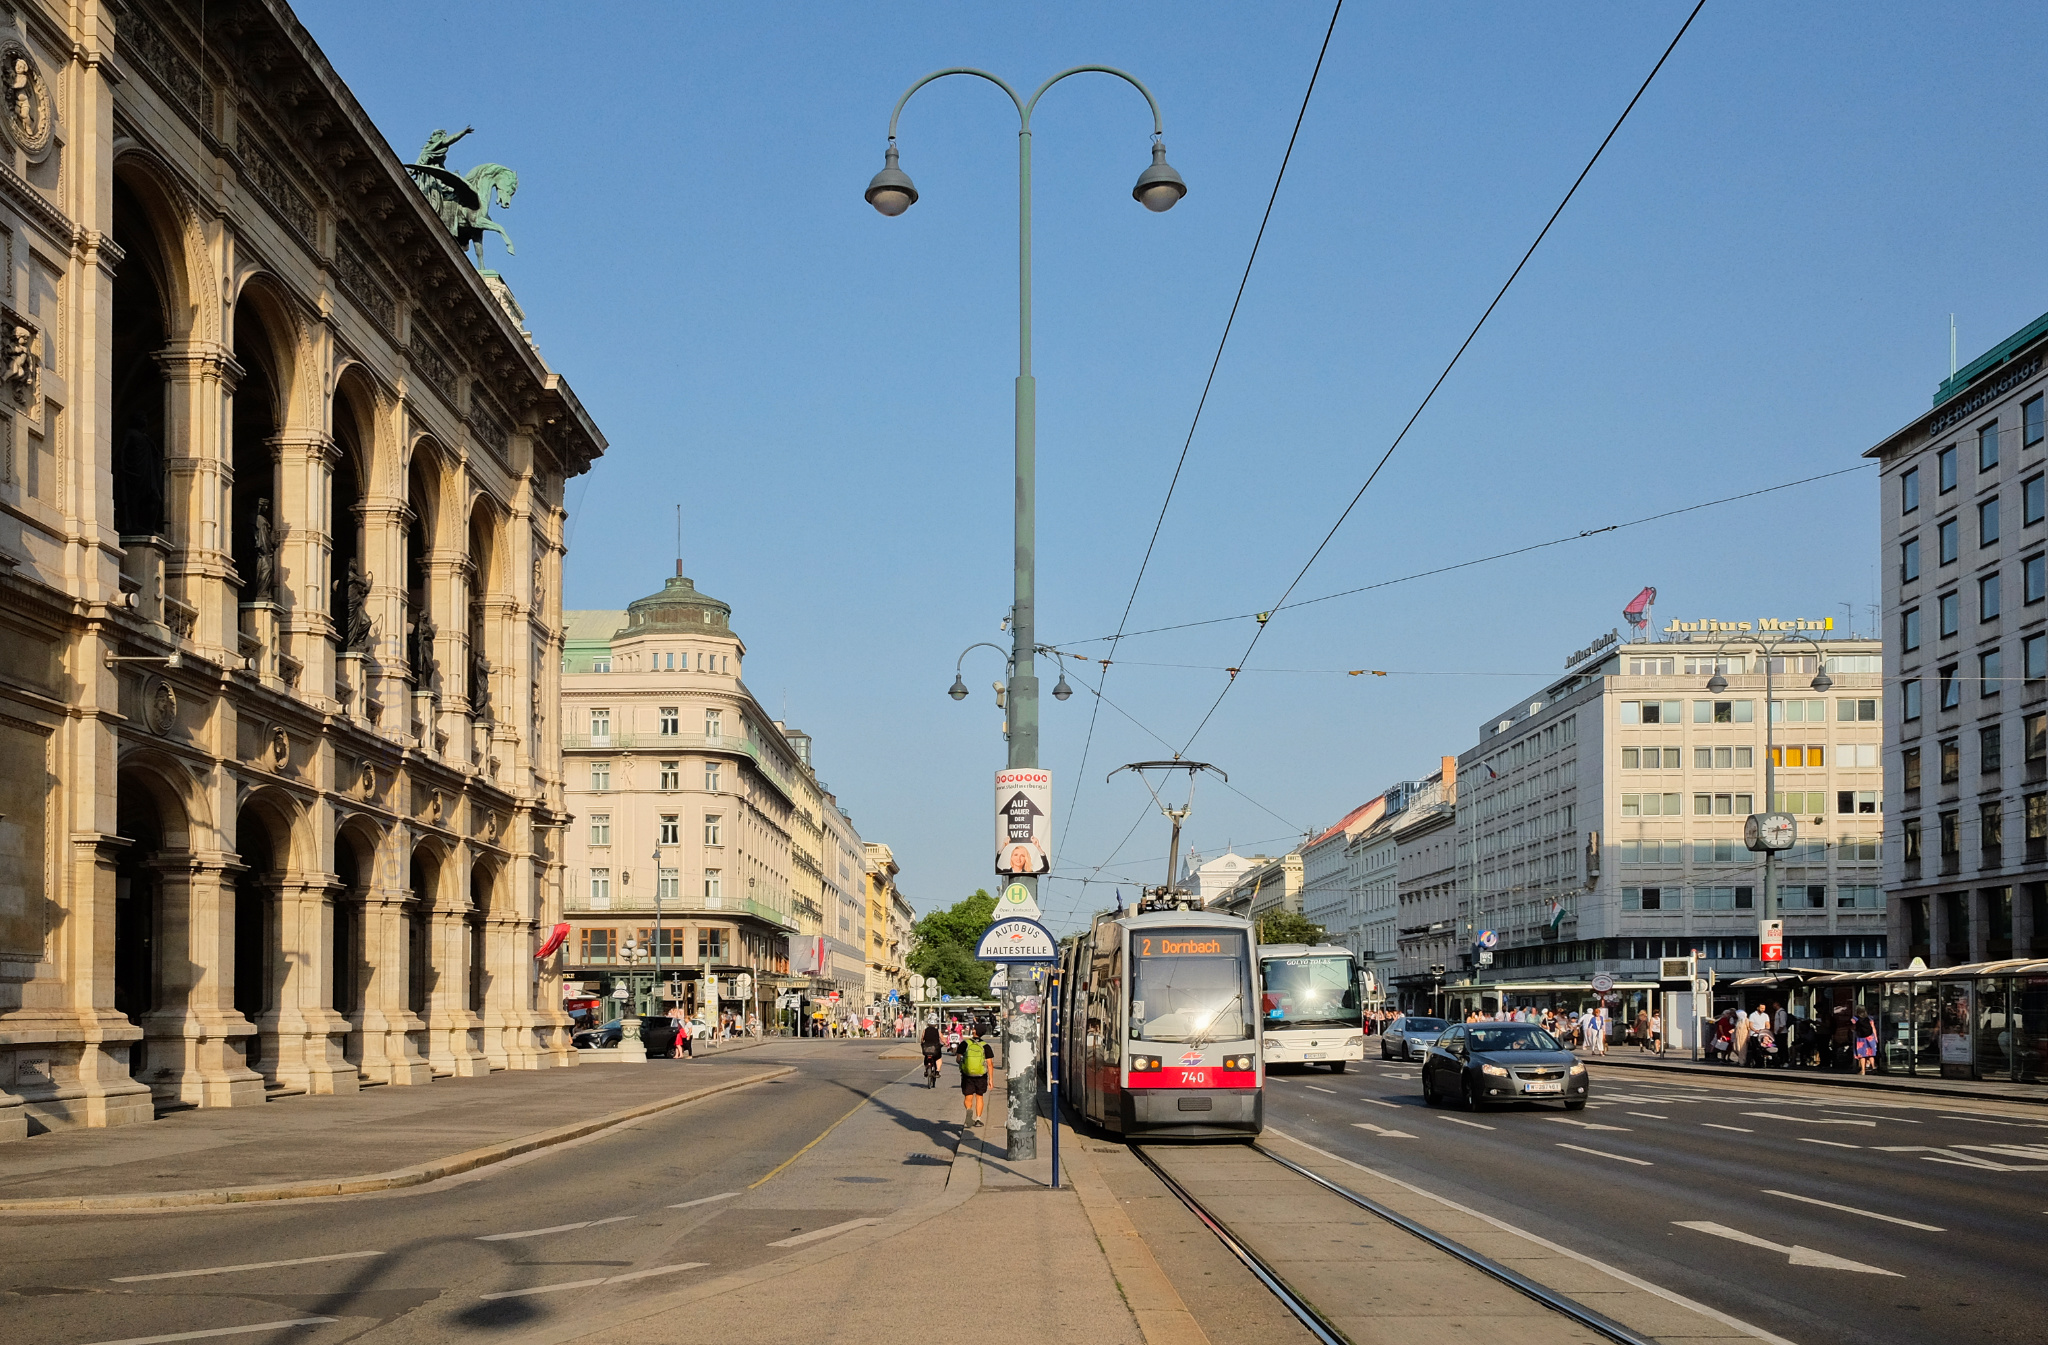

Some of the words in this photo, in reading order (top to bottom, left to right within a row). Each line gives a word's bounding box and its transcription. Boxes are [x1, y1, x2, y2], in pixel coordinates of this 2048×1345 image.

[1929, 356, 2042, 436] OPERNRINGHOF
[1663, 619, 1752, 632] Julius
[1758, 617, 1834, 631] Meinl
[1564, 645, 1592, 669] Julius
[1591, 628, 1618, 653] Meinl
[1012, 888, 1022, 900] H
[995, 923, 1040, 938] AUTOBUS
[986, 946, 1047, 955] HALTESTELLE
[1142, 938, 1151, 956] 2
[1162, 939, 1220, 954] Dornbach
[1181, 1072, 1205, 1084] 740
